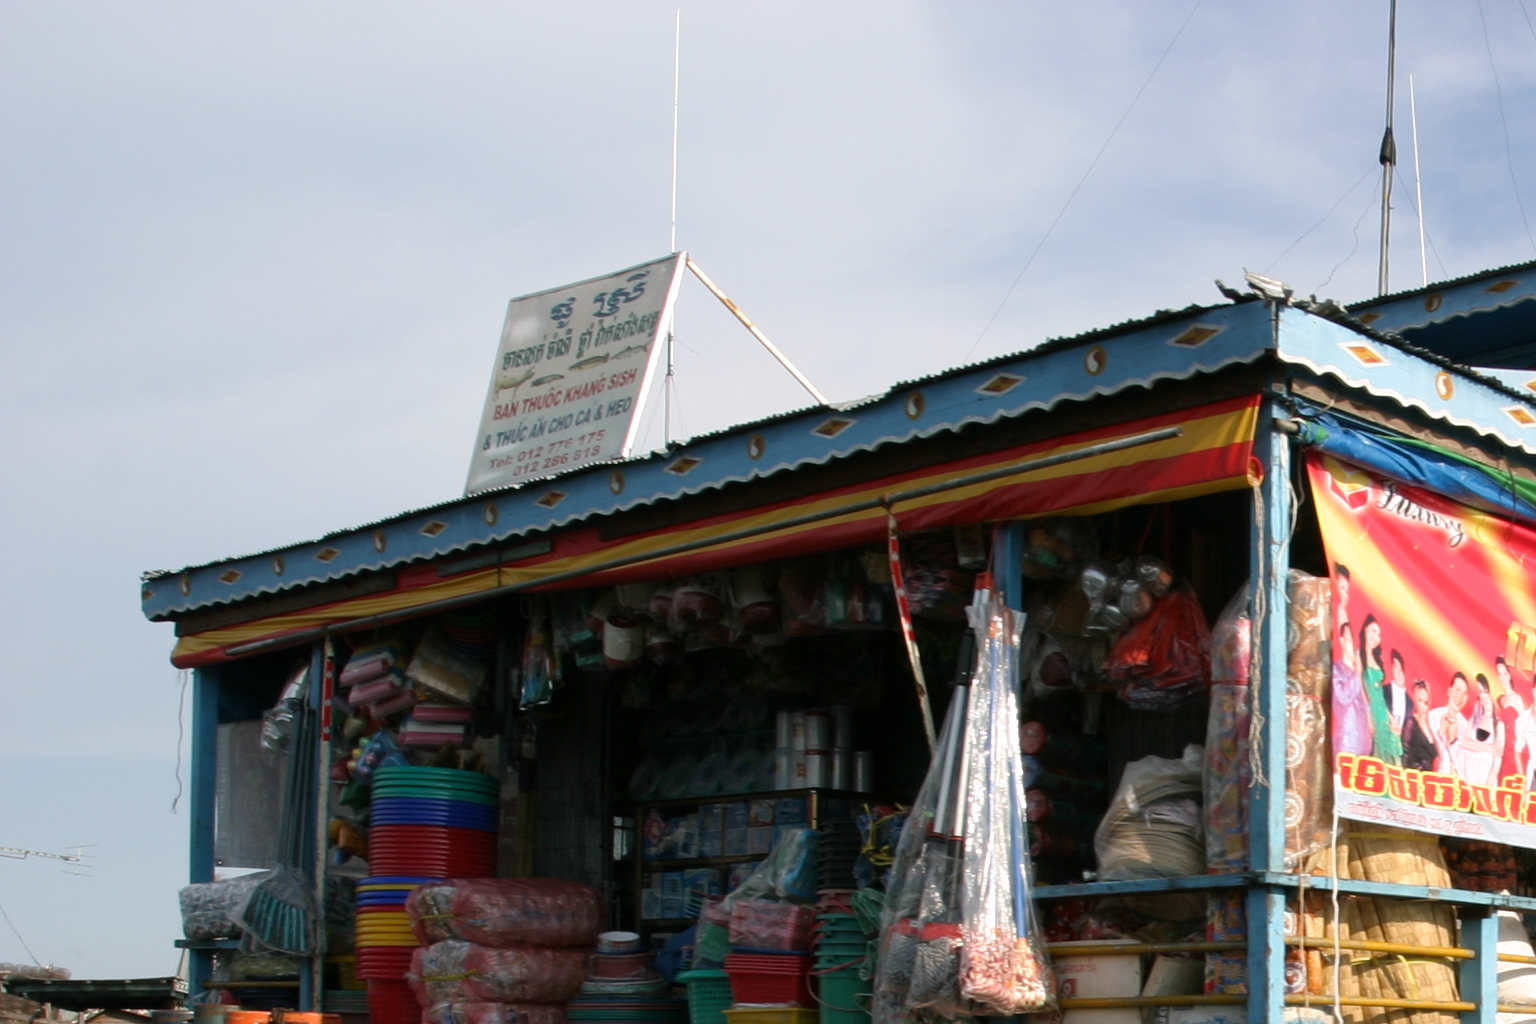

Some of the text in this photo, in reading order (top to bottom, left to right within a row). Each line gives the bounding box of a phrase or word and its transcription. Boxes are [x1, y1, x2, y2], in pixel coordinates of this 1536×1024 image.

[605, 395, 632, 418] HEO
[517, 444, 545, 462] 012
[512, 460, 540, 477] 012
